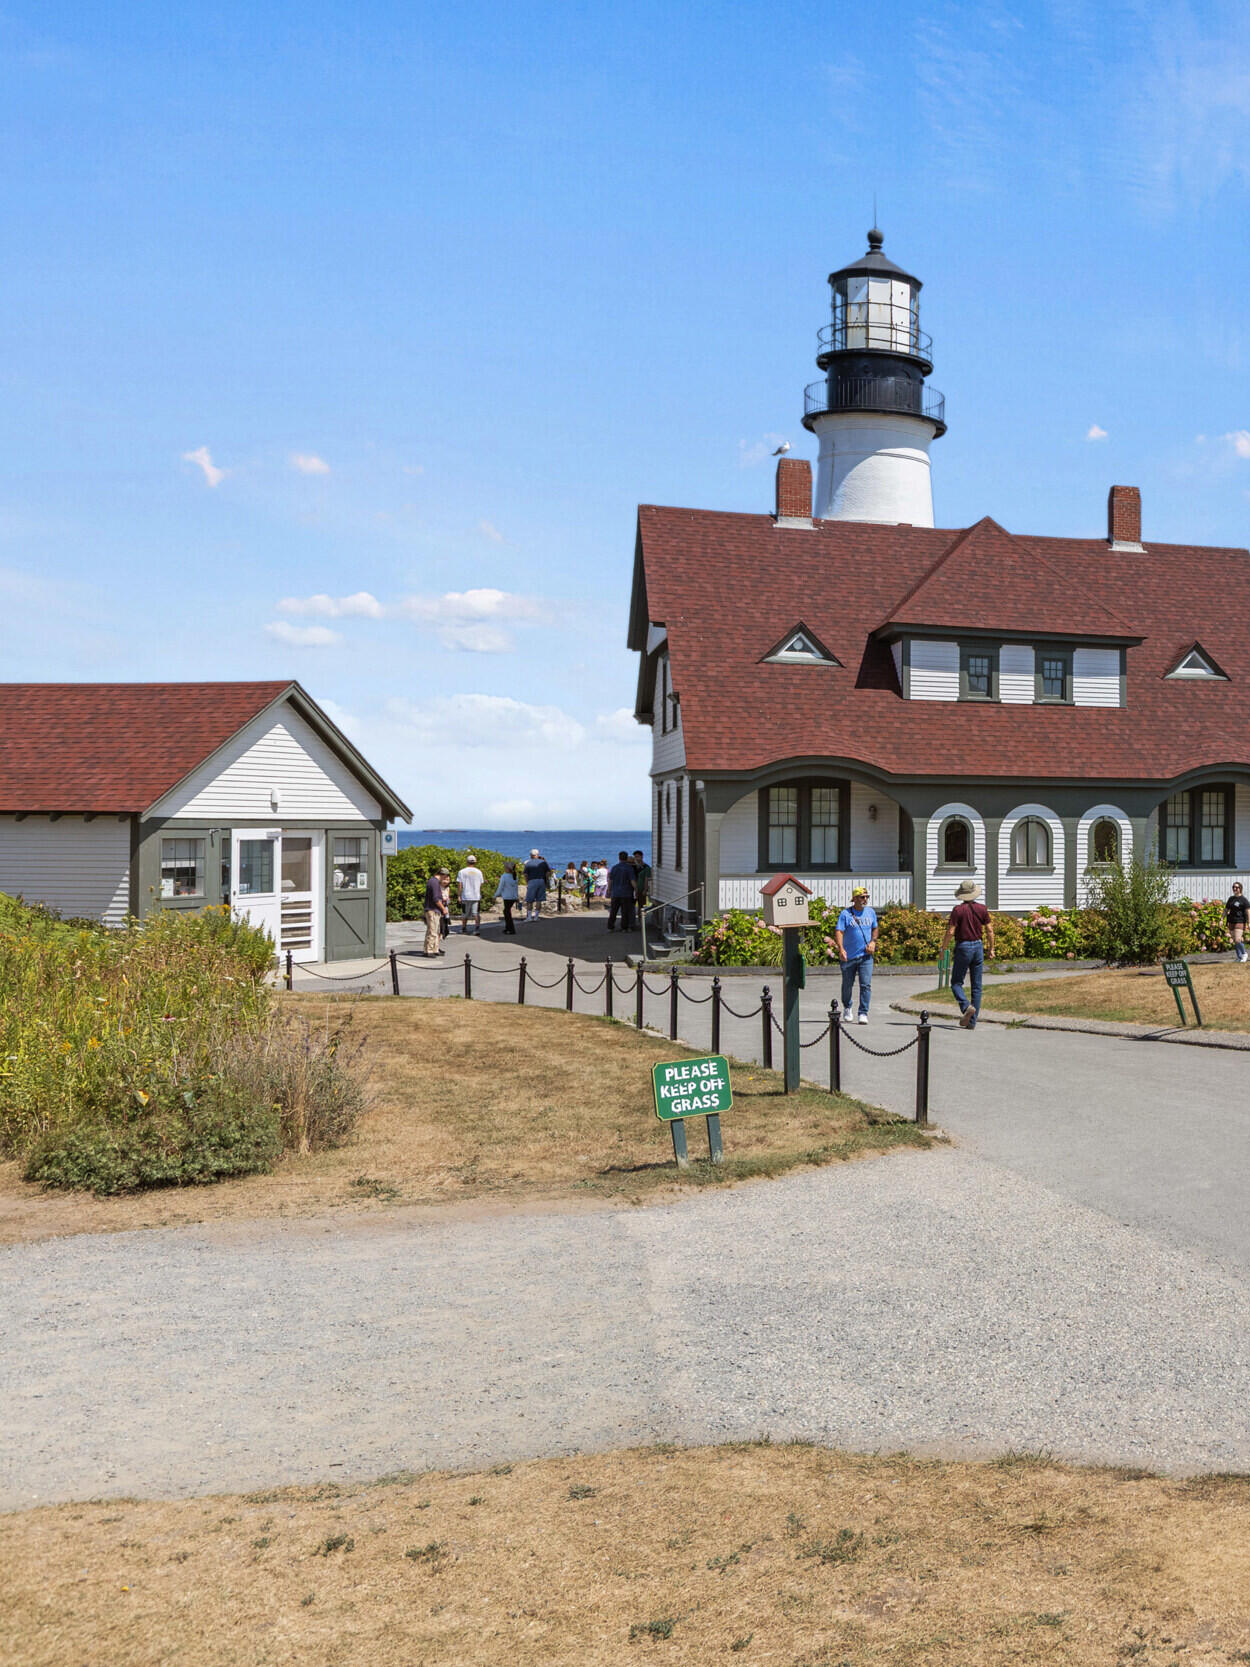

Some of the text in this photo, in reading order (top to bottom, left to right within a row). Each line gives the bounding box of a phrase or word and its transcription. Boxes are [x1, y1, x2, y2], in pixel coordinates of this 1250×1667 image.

[665, 1062, 718, 1081] PLEASE
[660, 1078, 726, 1098] KEEP OFF
[671, 1093, 720, 1113] GRASS
